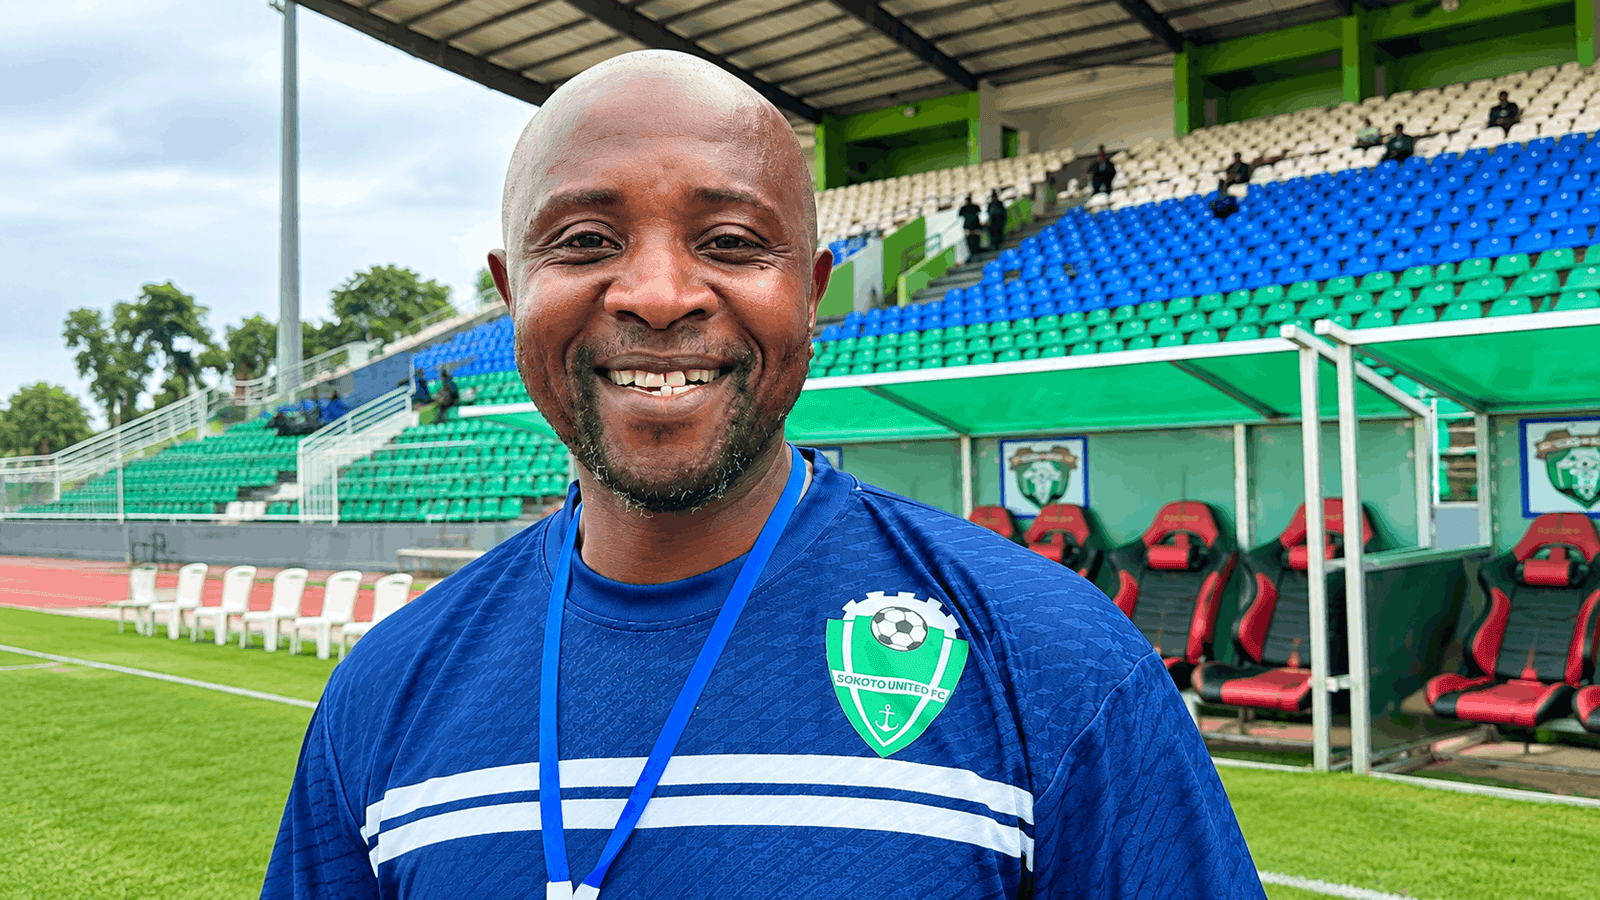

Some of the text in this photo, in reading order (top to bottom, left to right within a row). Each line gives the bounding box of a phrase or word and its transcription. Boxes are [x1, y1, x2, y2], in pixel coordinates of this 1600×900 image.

[836, 674, 946, 700] SOKOTO UNITED FC
